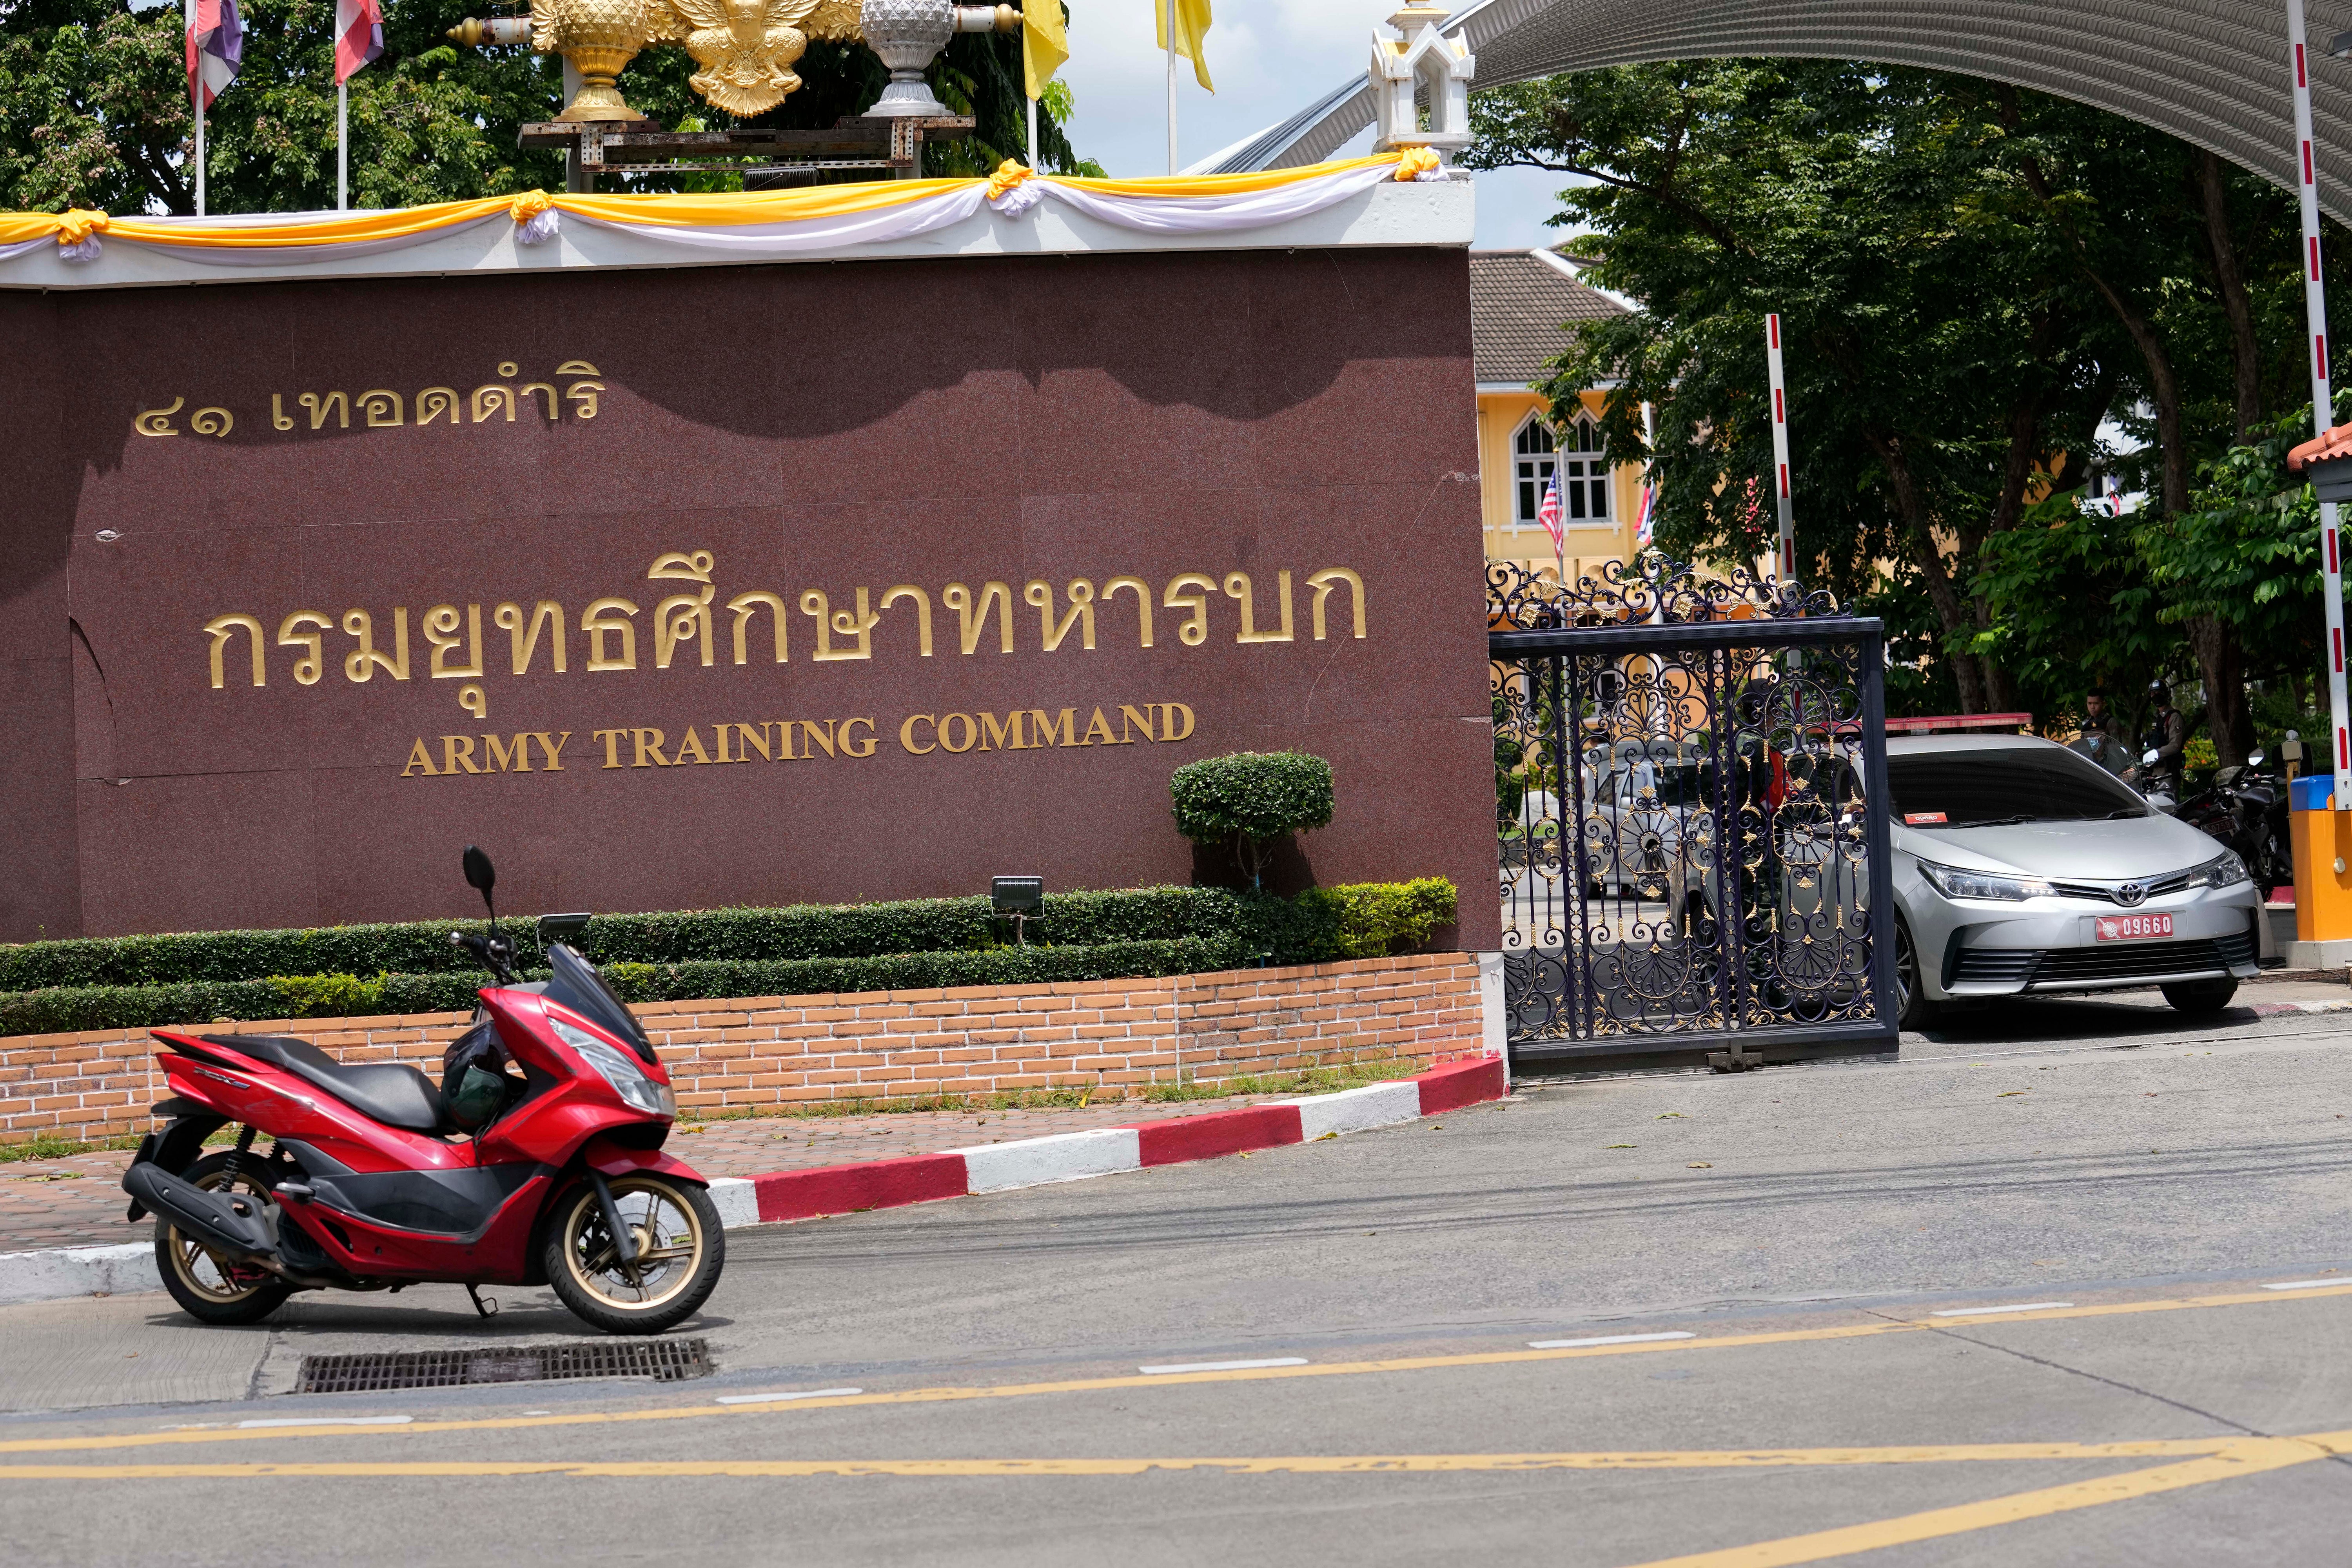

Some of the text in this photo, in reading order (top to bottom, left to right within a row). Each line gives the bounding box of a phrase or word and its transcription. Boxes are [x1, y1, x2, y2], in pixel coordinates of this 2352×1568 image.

[134, 359, 606, 438] ๔๑ เทอดดำริ
[202, 548, 1367, 718] กรมยุทธศึกษาทหารบก
[400, 702, 1196, 777] ARMY TRAINING COMMAND
[2123, 916, 2171, 935] 09660
